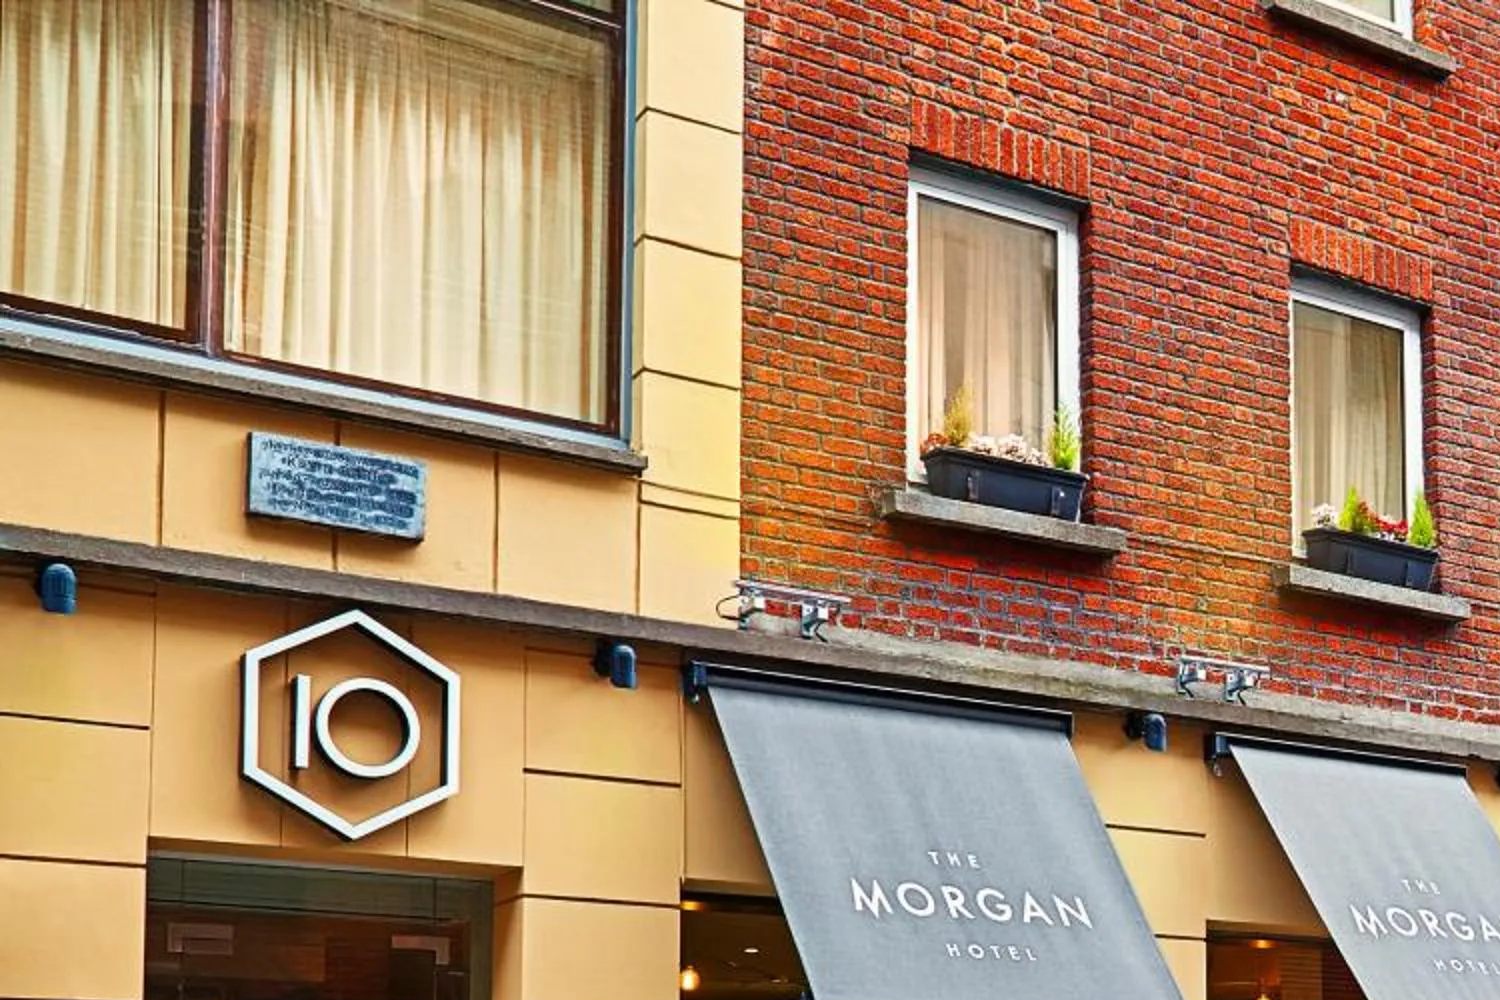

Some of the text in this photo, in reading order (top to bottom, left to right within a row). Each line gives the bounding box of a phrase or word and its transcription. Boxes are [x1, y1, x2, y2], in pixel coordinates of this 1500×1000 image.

[292, 673, 421, 779] 10
[927, 851, 981, 869] THE
[1401, 879, 1441, 895] THE
[850, 877, 1093, 929] MORGAN
[945, 943, 1037, 962] HOTEL
